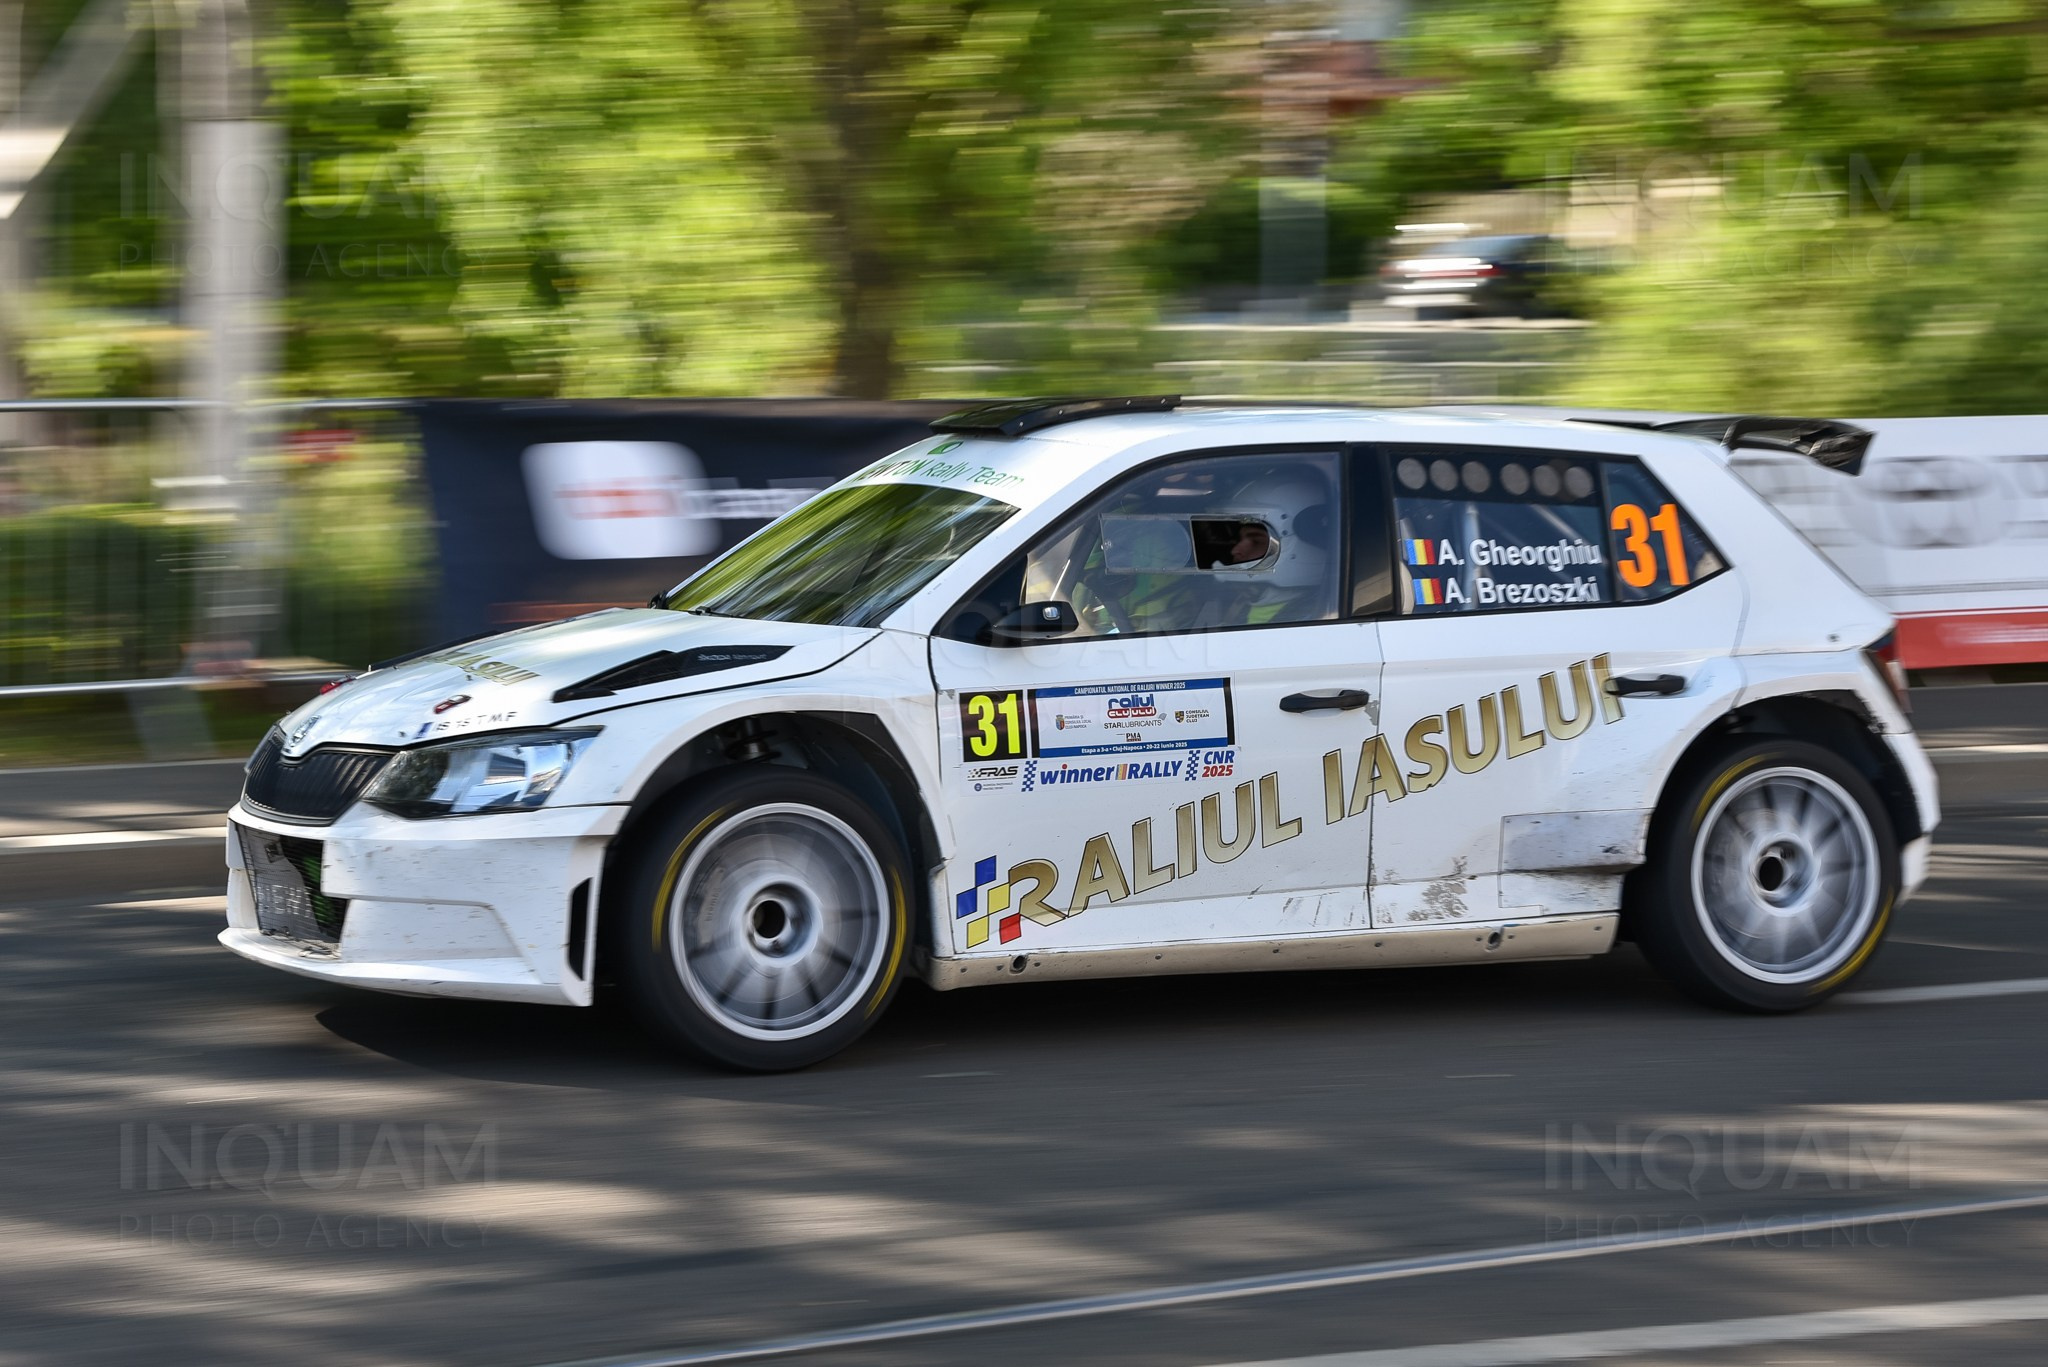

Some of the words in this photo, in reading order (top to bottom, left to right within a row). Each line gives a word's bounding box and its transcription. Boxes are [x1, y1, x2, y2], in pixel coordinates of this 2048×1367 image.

[920, 461, 974, 483] Rally
[967, 466, 1025, 489] Team
[1438, 539, 1464, 566] A.
[1470, 538, 1602, 572] Gheorghiu
[1610, 503, 1690, 588] 31
[1445, 578, 1472, 604] A.
[1477, 576, 1600, 604] Brezoszki
[1074, 687, 1106, 695] CAMPIONATUL
[1130, 684, 1136, 692] DE
[1156, 682, 1173, 690] WINNER
[1174, 681, 1185, 689] 2025
[1108, 694, 1155, 709] raliul
[968, 693, 1020, 757] 31
[1322, 651, 1626, 825] IASULUI
[1112, 745, 1142, 753] Cluj-Napoca
[1203, 750, 1235, 765] CNR
[977, 765, 1019, 777] FRAS
[1040, 763, 1115, 785] winner
[1127, 761, 1183, 779] RALLY
[1202, 765, 1233, 778] 2025
[1007, 771, 1303, 926] RALIUL
